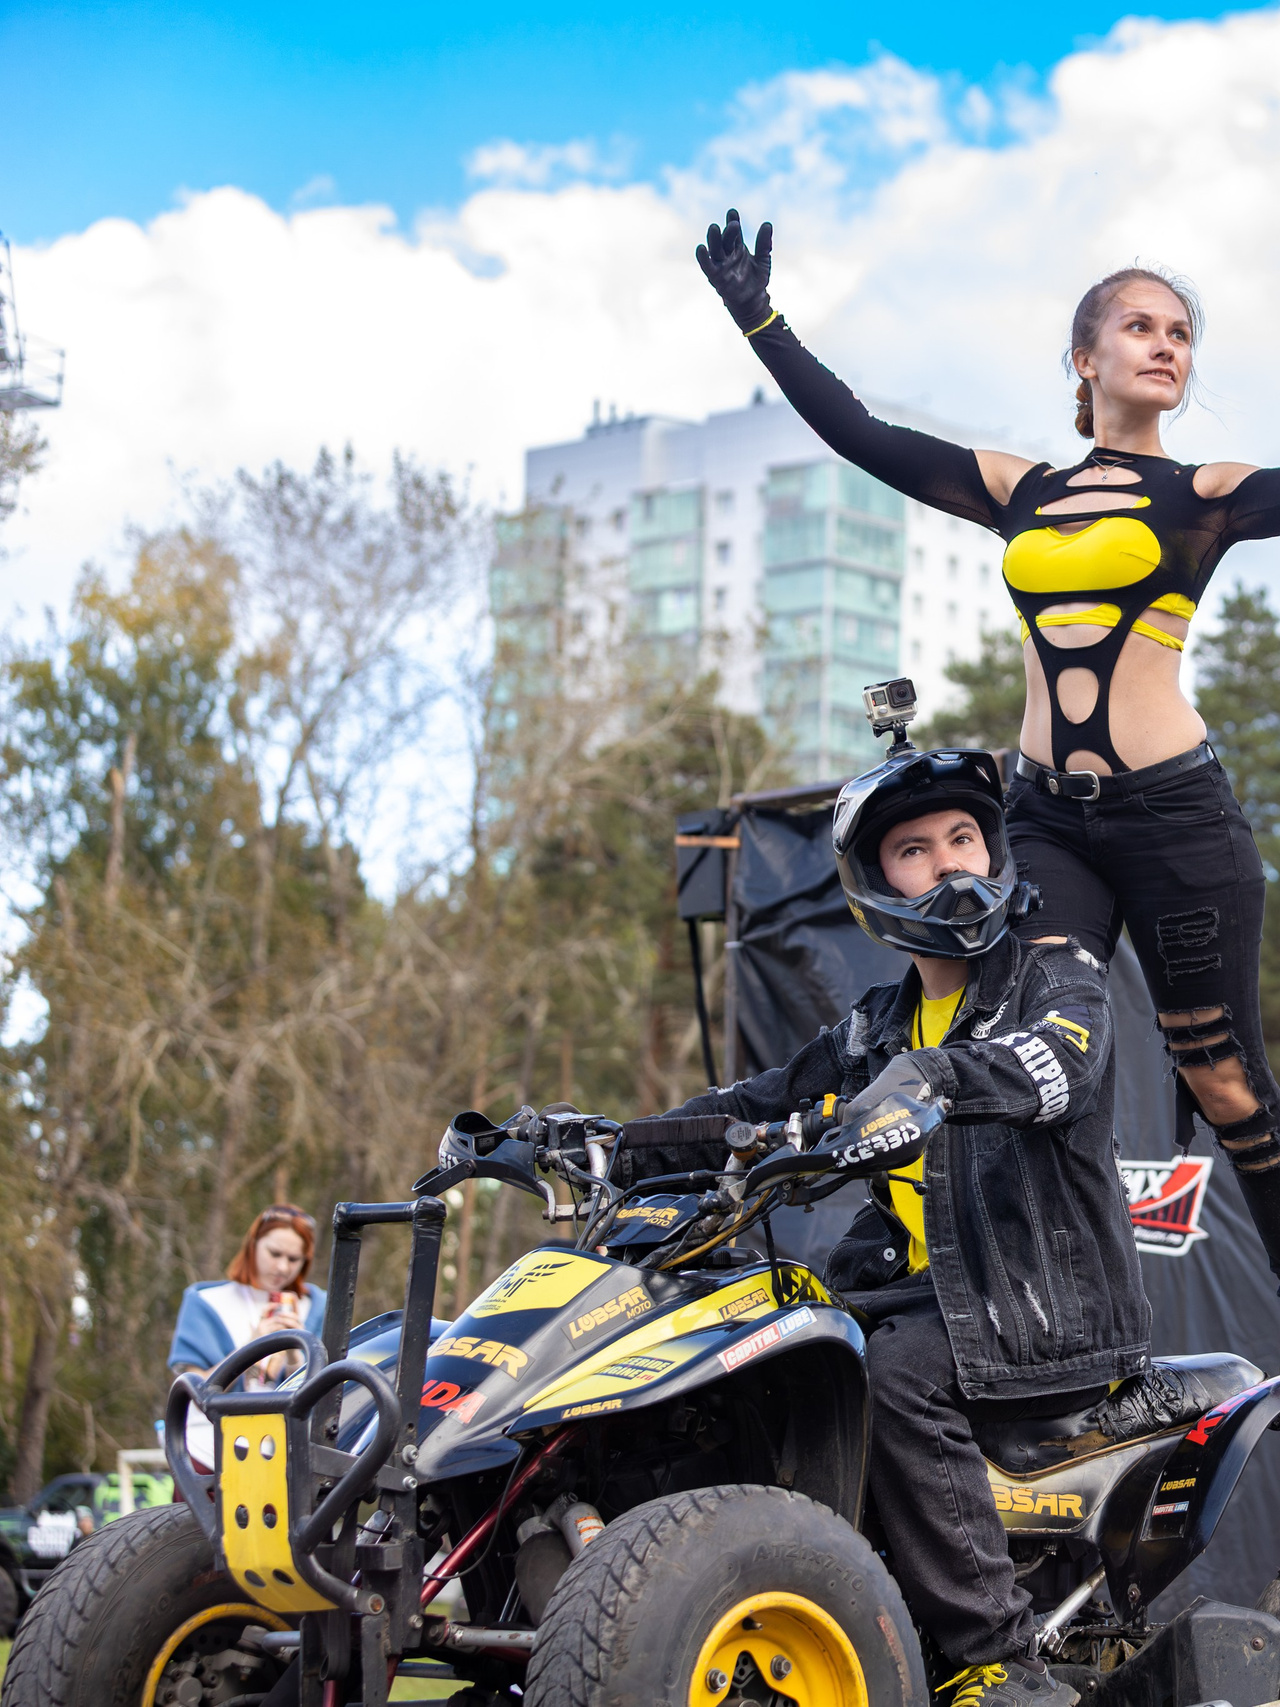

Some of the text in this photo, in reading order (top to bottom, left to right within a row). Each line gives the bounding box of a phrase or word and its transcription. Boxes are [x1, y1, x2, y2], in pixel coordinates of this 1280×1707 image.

[860, 1108, 912, 1138] LUBSAR
[616, 1206, 679, 1221] UBSAR
[643, 1217, 670, 1227] MOTO
[568, 1286, 648, 1340] LUBSAR
[626, 1300, 652, 1319] MOTO
[721, 1289, 769, 1320] LUBSAR
[725, 1309, 810, 1367] CAPITAL LUBE
[427, 1336, 528, 1379] BSAR
[561, 1399, 623, 1419] LUBSAR
[1160, 1477, 1197, 1491] LUBSAR
[991, 1484, 1084, 1518] BSAR
